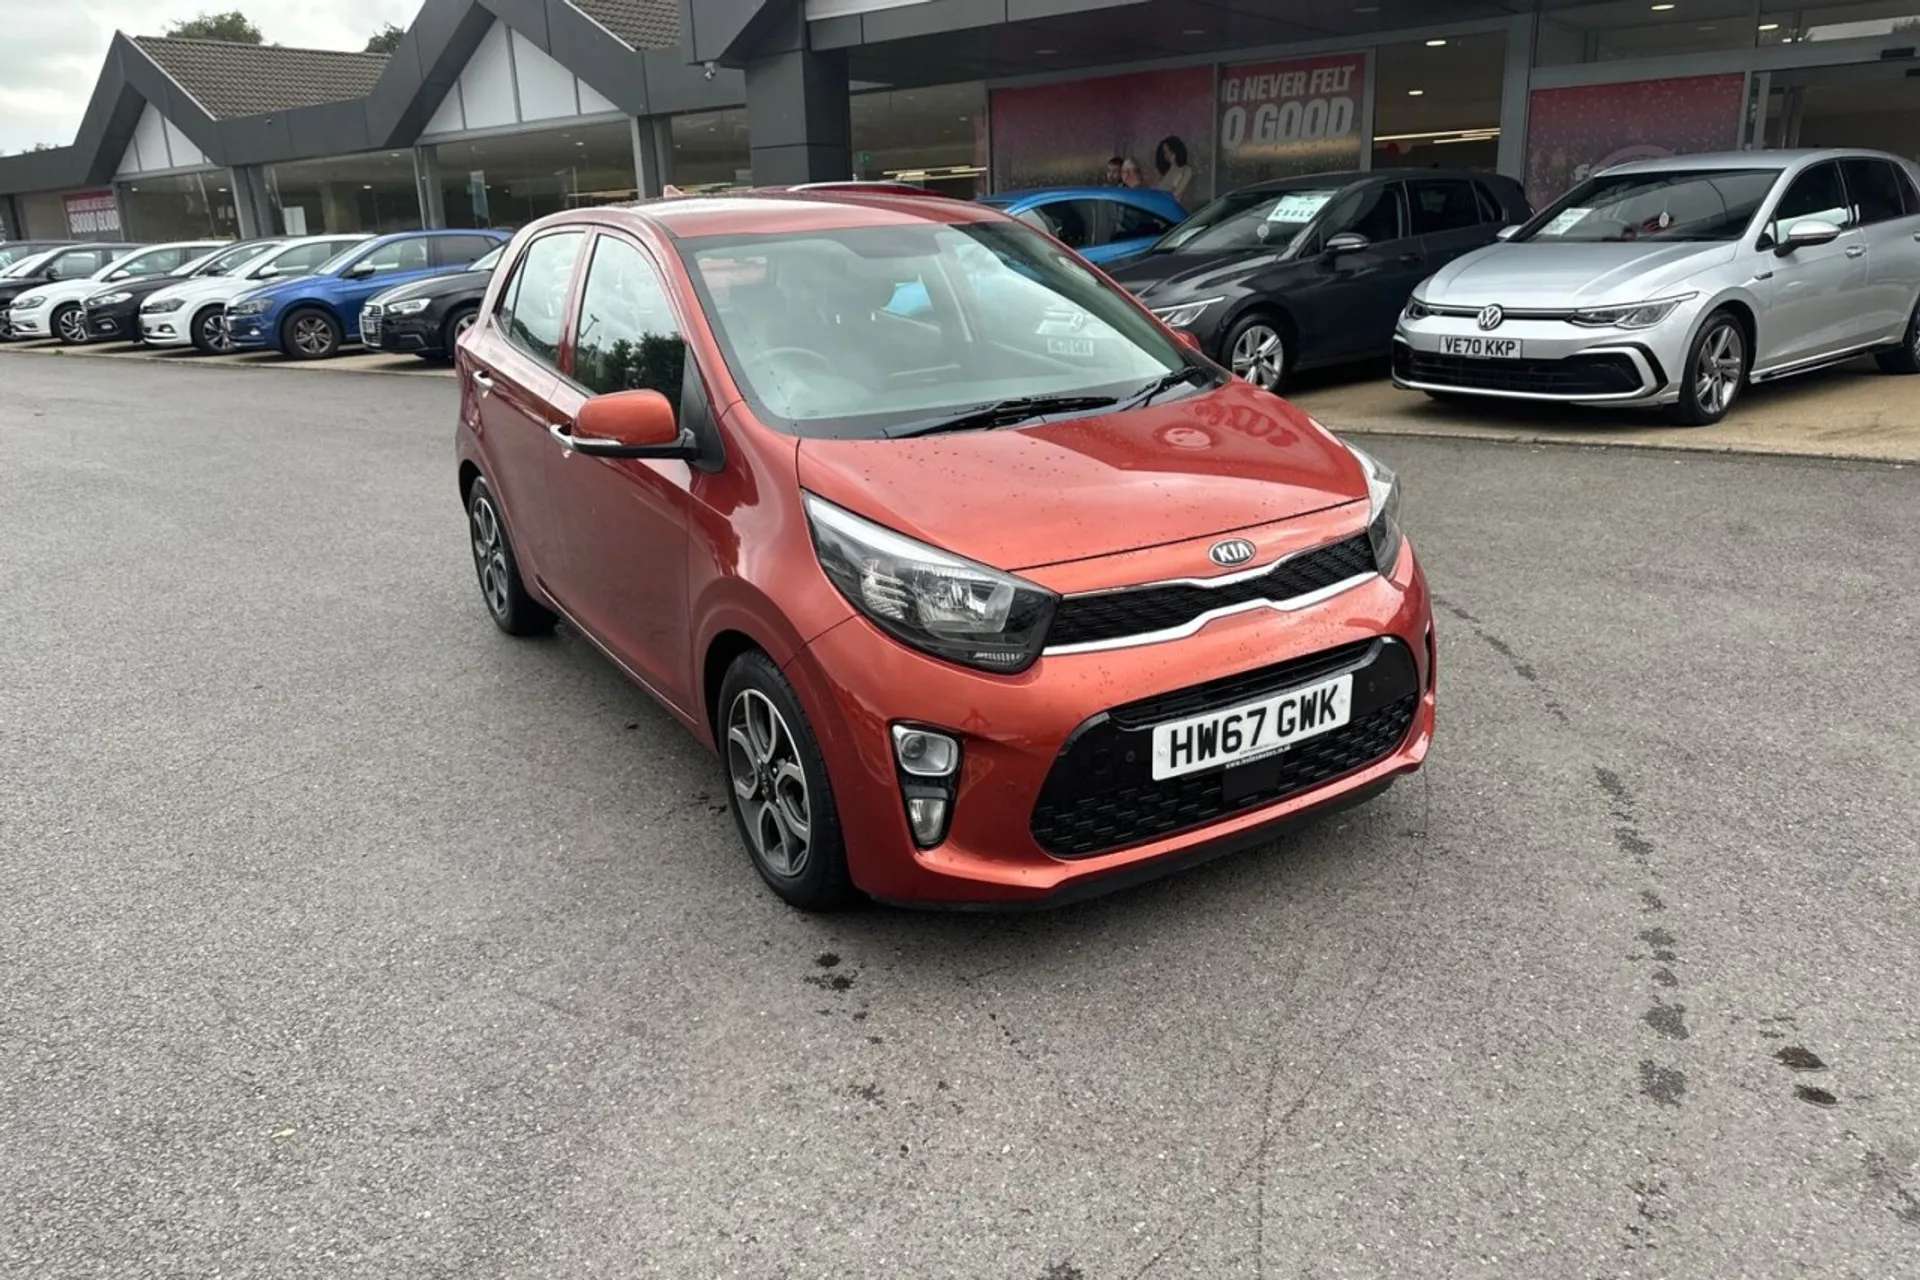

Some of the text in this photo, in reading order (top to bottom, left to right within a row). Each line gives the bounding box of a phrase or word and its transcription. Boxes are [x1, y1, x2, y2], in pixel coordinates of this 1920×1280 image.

[1242, 70, 1307, 101] NEVER
[1309, 64, 1356, 95] FELT
[1251, 96, 1354, 146] GOOD
[1445, 337, 1516, 356] VE70 KKP
[1215, 542, 1251, 562] KIA
[1170, 706, 1268, 769] HW67
[1276, 684, 1339, 738] GWK
